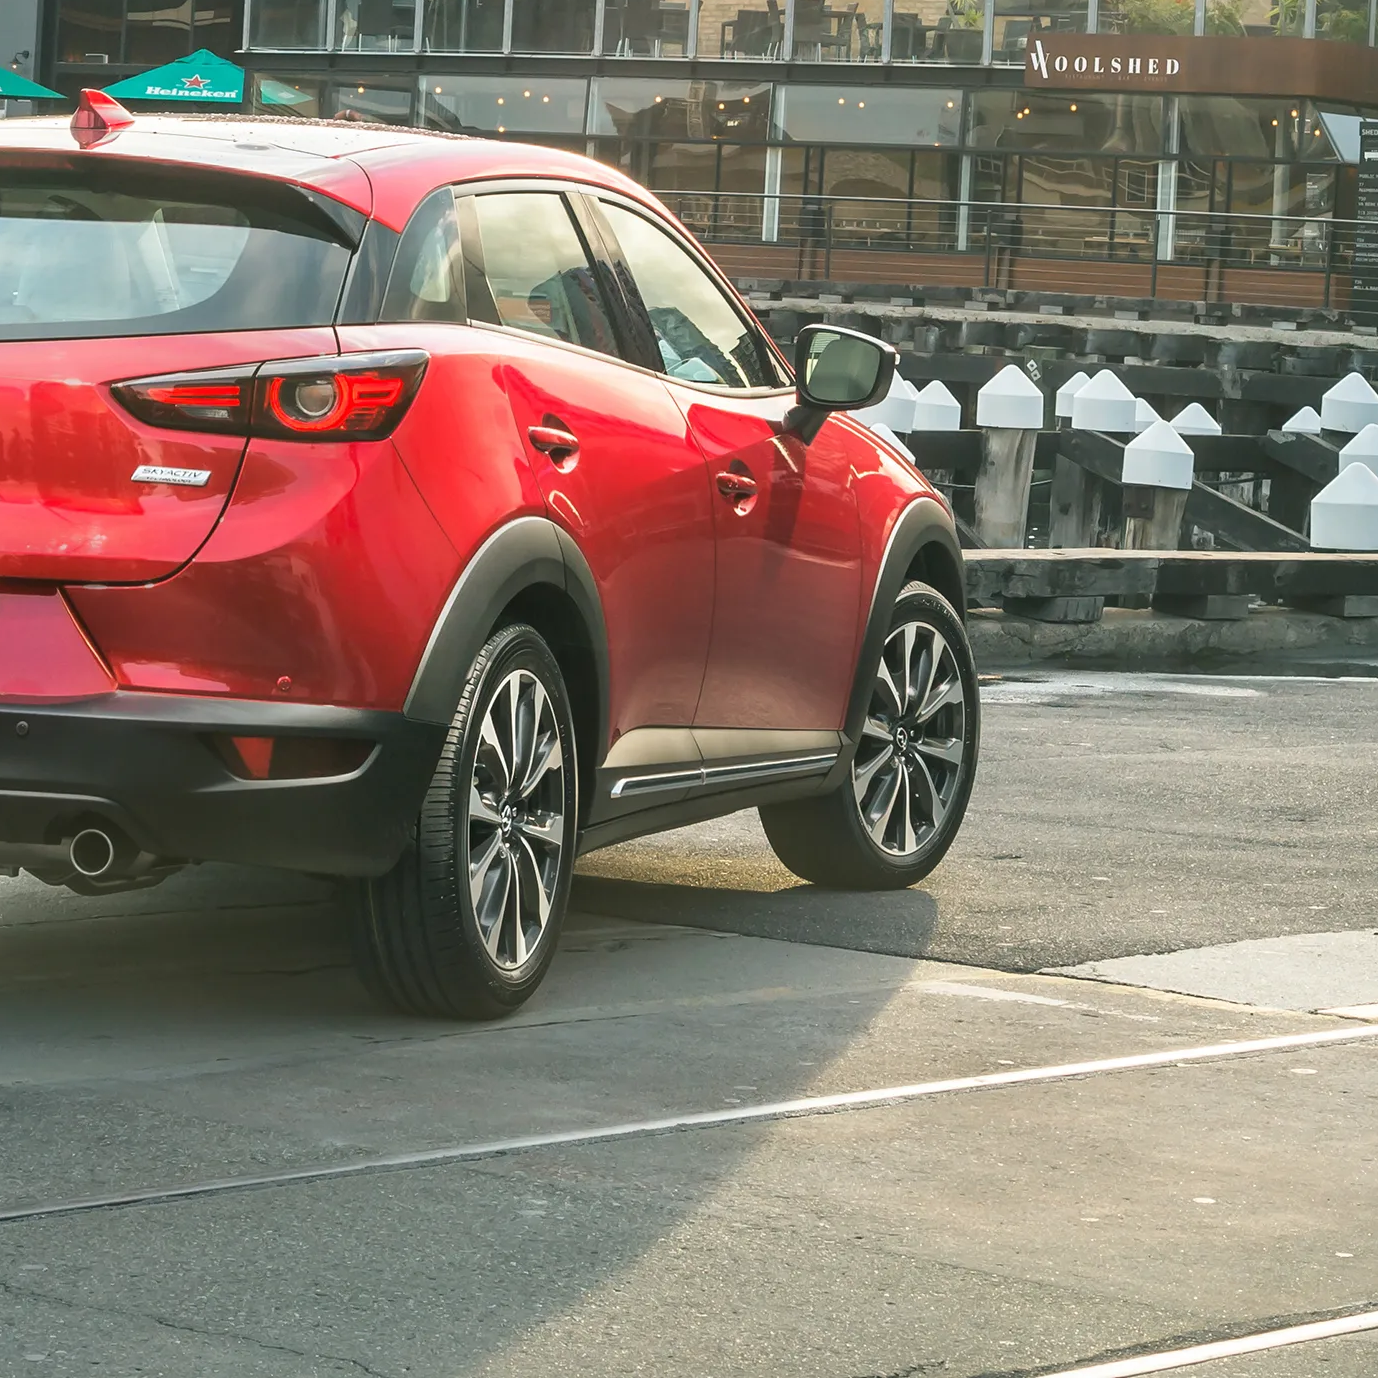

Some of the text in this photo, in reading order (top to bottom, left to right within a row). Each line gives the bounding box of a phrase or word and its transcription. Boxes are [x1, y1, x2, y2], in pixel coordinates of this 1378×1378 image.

[1030, 40, 1181, 79] WOOLSHED
[145, 85, 238, 99] Heineken
[1361, 128, 1378, 136] SHED
[142, 468, 203, 479] SKYACTIV
